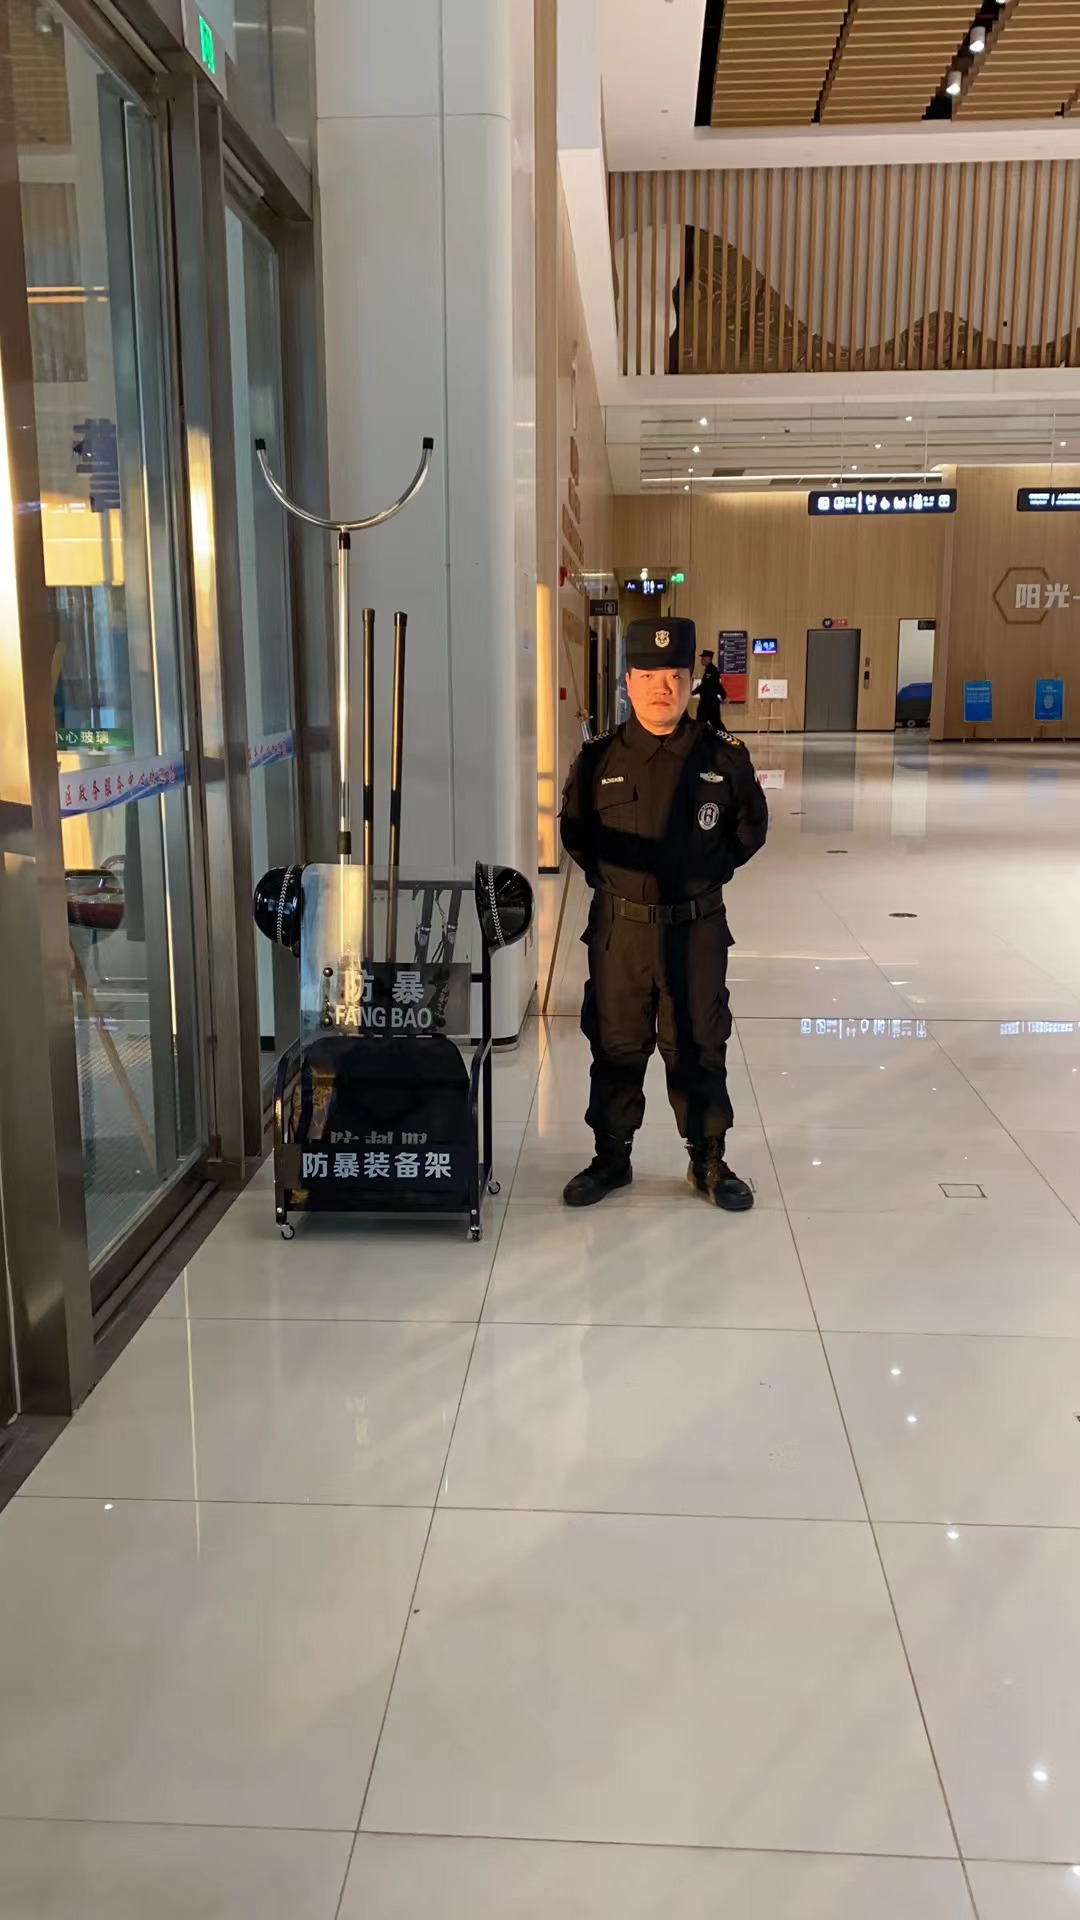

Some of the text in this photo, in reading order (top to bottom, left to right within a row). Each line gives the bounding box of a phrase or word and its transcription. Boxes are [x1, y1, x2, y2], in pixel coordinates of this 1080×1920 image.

[1015, 583, 1080, 608] 阳光
[344, 969, 424, 1004] 防暴
[335, 1004, 432, 1029] FANG BAO
[302, 1152, 452, 1178] 防暴装备架
